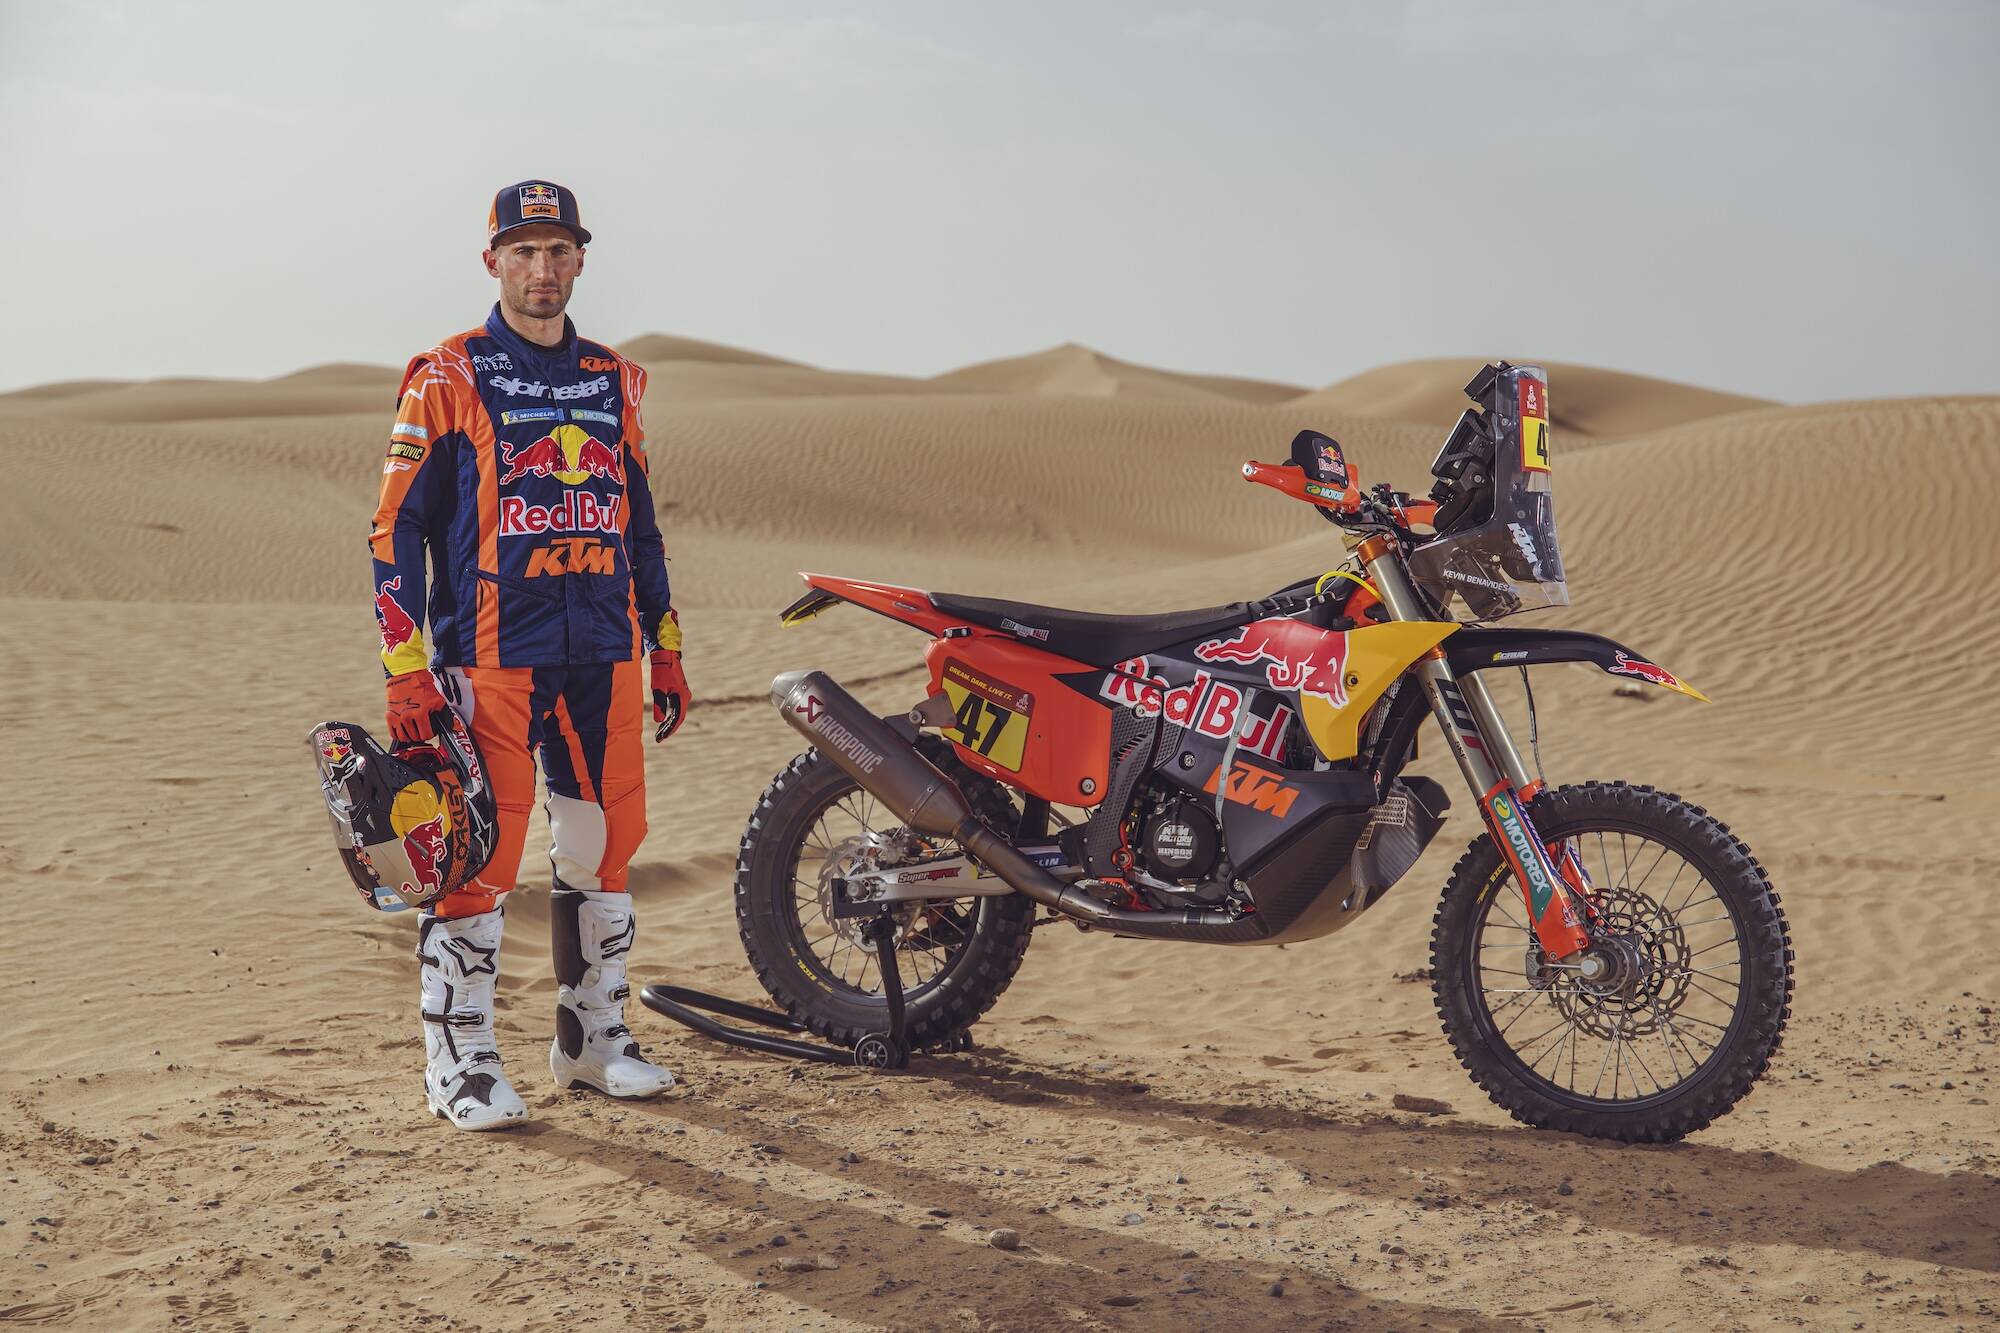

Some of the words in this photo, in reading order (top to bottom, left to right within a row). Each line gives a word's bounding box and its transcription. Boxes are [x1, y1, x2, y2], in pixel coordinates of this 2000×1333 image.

[492, 362, 513, 371] BAG
[580, 356, 617, 372] KTM
[489, 375, 610, 400] alpinestars
[1537, 422, 1550, 467] 4
[499, 489, 576, 536] Red
[524, 537, 616, 578] KTM
[1507, 523, 1538, 563] KTM
[1443, 569, 1466, 581] KEVIN
[1467, 575, 1509, 592] BENAVIDES
[949, 666, 971, 681] DREAM.
[970, 677, 988, 690] DARE.
[988, 686, 1005, 698] LIVE
[955, 692, 1012, 756] 47
[1099, 655, 1211, 730] Red
[1195, 681, 1295, 764] Bul
[815, 714, 884, 774] AKRAPOVIČ
[1203, 760, 1300, 819] KTM
[444, 780, 469, 861] OAKLEY
[1158, 834, 1193, 843] FACTORY
[1503, 817, 1551, 893] MOTOREX
